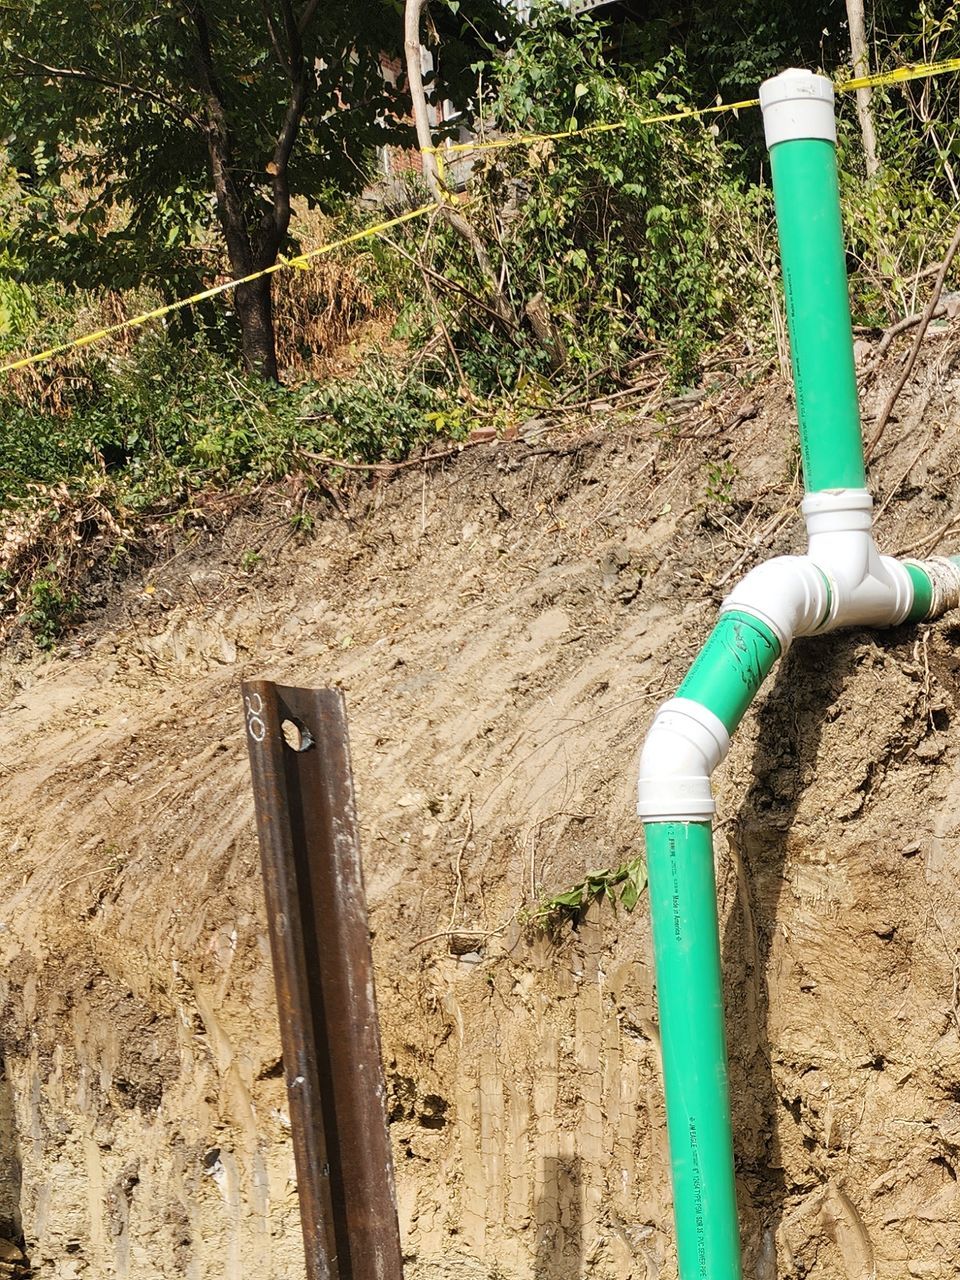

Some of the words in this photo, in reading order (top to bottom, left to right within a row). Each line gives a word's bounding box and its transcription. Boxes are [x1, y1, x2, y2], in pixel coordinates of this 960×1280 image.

[671, 895, 679, 908] Made
[673, 914, 681, 935] America
[690, 1131, 698, 1148] EAGLE
[693, 1189, 701, 1202] TYPE
[697, 1247, 706, 1265] SEWER
